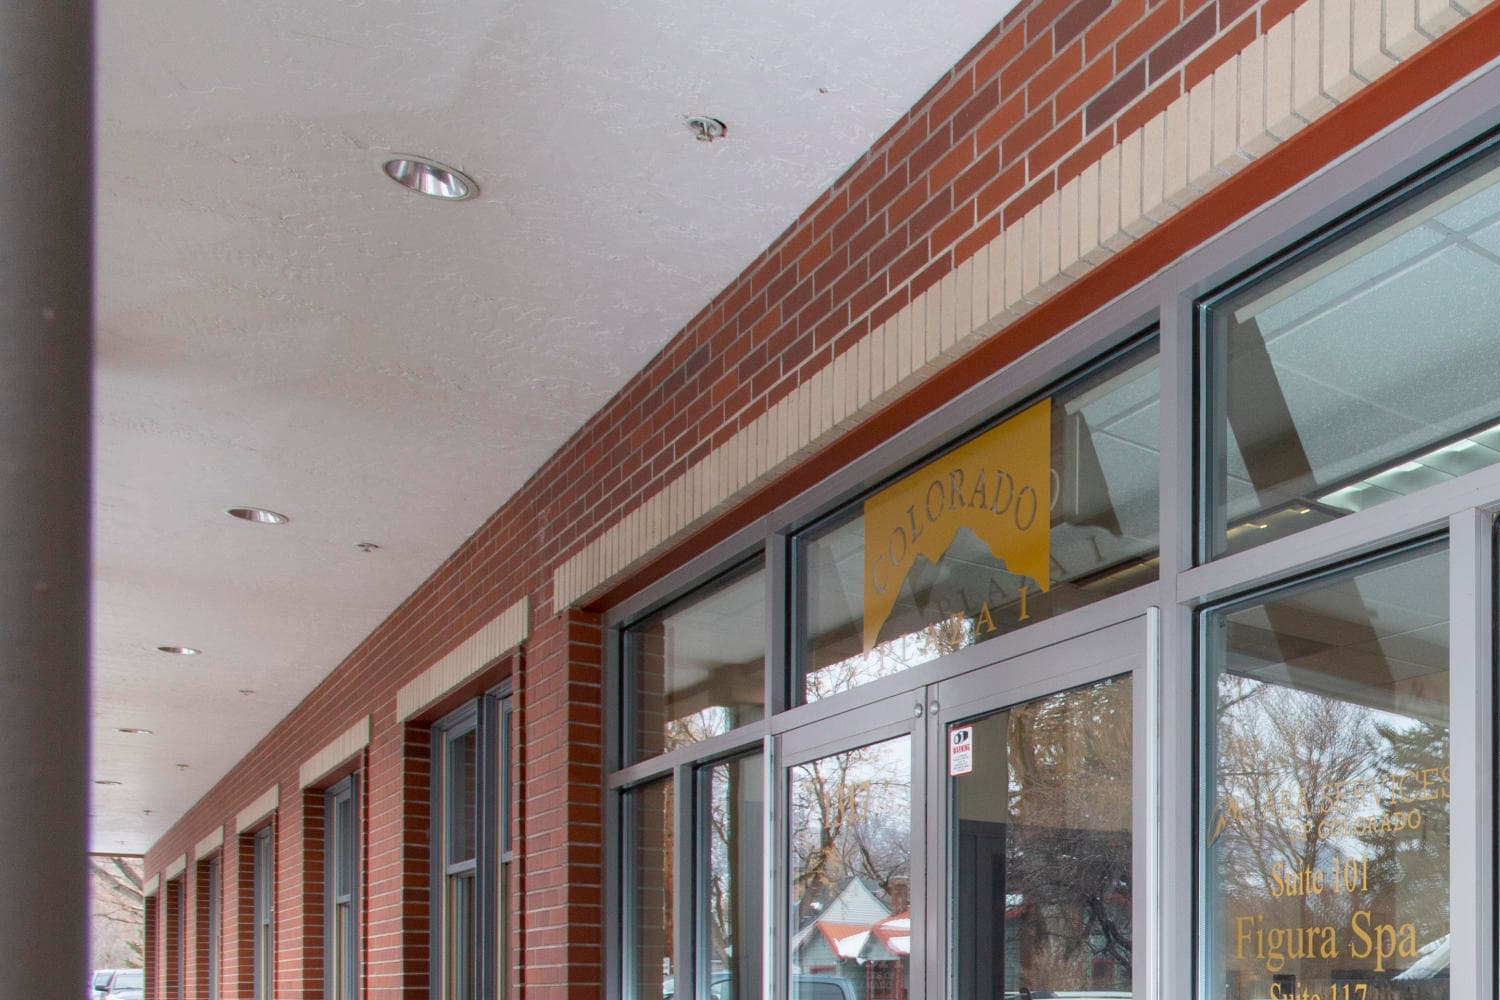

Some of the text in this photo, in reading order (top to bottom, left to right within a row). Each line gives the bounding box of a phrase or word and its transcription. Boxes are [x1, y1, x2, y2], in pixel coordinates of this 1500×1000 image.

[872, 468, 1038, 594] COLORADO
[1317, 809, 1421, 839] COLORADO
[1270, 855, 1368, 897] Suite 101
[1235, 911, 1418, 972] Figura Spa
